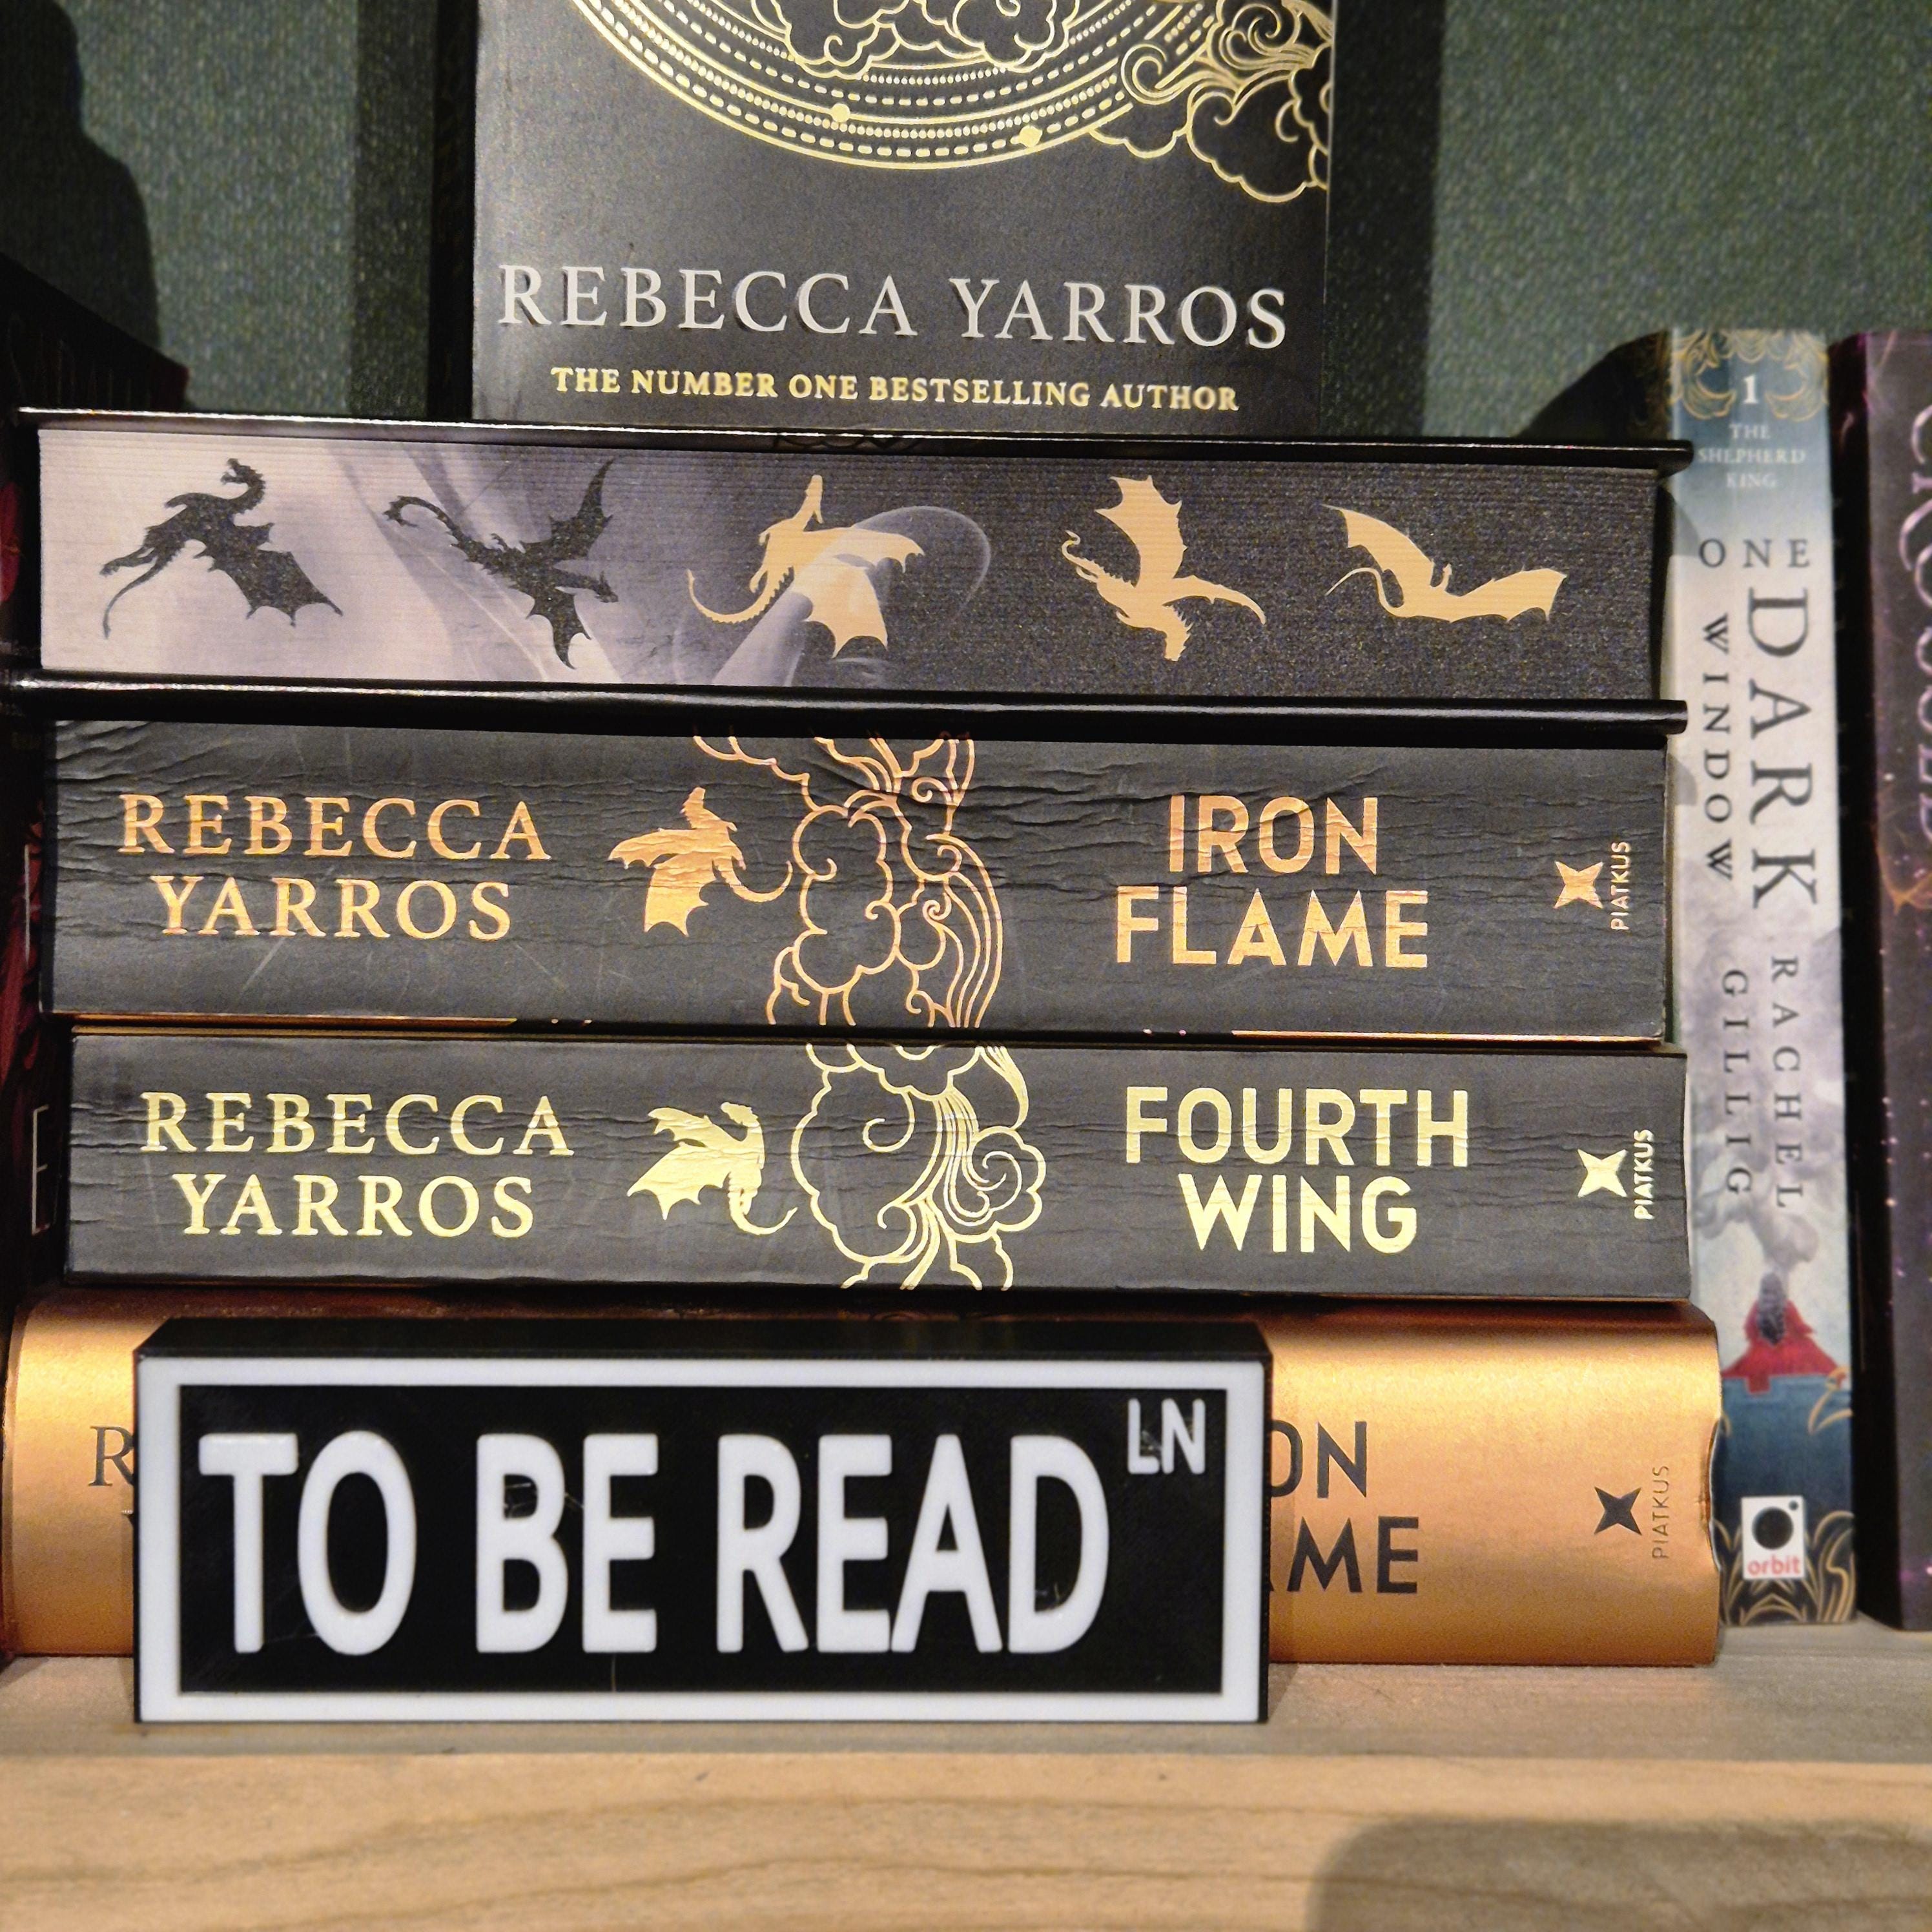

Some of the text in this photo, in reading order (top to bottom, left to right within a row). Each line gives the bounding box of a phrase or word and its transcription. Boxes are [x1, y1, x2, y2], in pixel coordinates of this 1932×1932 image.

[497, 263, 1286, 349] REBECCA YARROS
[550, 367, 1239, 411] THE NUMBER ONE BESTSELLING AUTHOR
[1743, 374, 1759, 405] 1
[1698, 447, 1807, 465] SHEPHERD
[1729, 424, 1771, 440] THE
[1726, 472, 1776, 489] KING
[1699, 538, 1811, 569] ONE
[1703, 613, 1733, 881] WINDOW
[1747, 588, 1817, 909] DARK
[118, 794, 551, 860] REBECCA
[1169, 795, 1378, 875] IRON
[150, 875, 511, 941] YARROS
[1610, 841, 1631, 930] PIATKUS
[1116, 886, 1428, 969] FLAME
[1723, 969, 1752, 1194] GILLIG
[1771, 956, 1804, 1208] RACHEL
[140, 1092, 575, 1156] REBECCA
[1125, 1086, 1468, 1167] FOURTH
[171, 1173, 533, 1238] YARROS
[1178, 1173, 1417, 1253] WING
[1633, 1129, 1654, 1220] PIATKUS
[1127, 1399, 1206, 1474] LN
[1271, 1419, 1368, 1499] ON
[199, 1430, 1109, 1655] TO BE READ
[1652, 1464, 1669, 1559] PIATKUS
[1748, 1554, 1802, 1576] orbit
